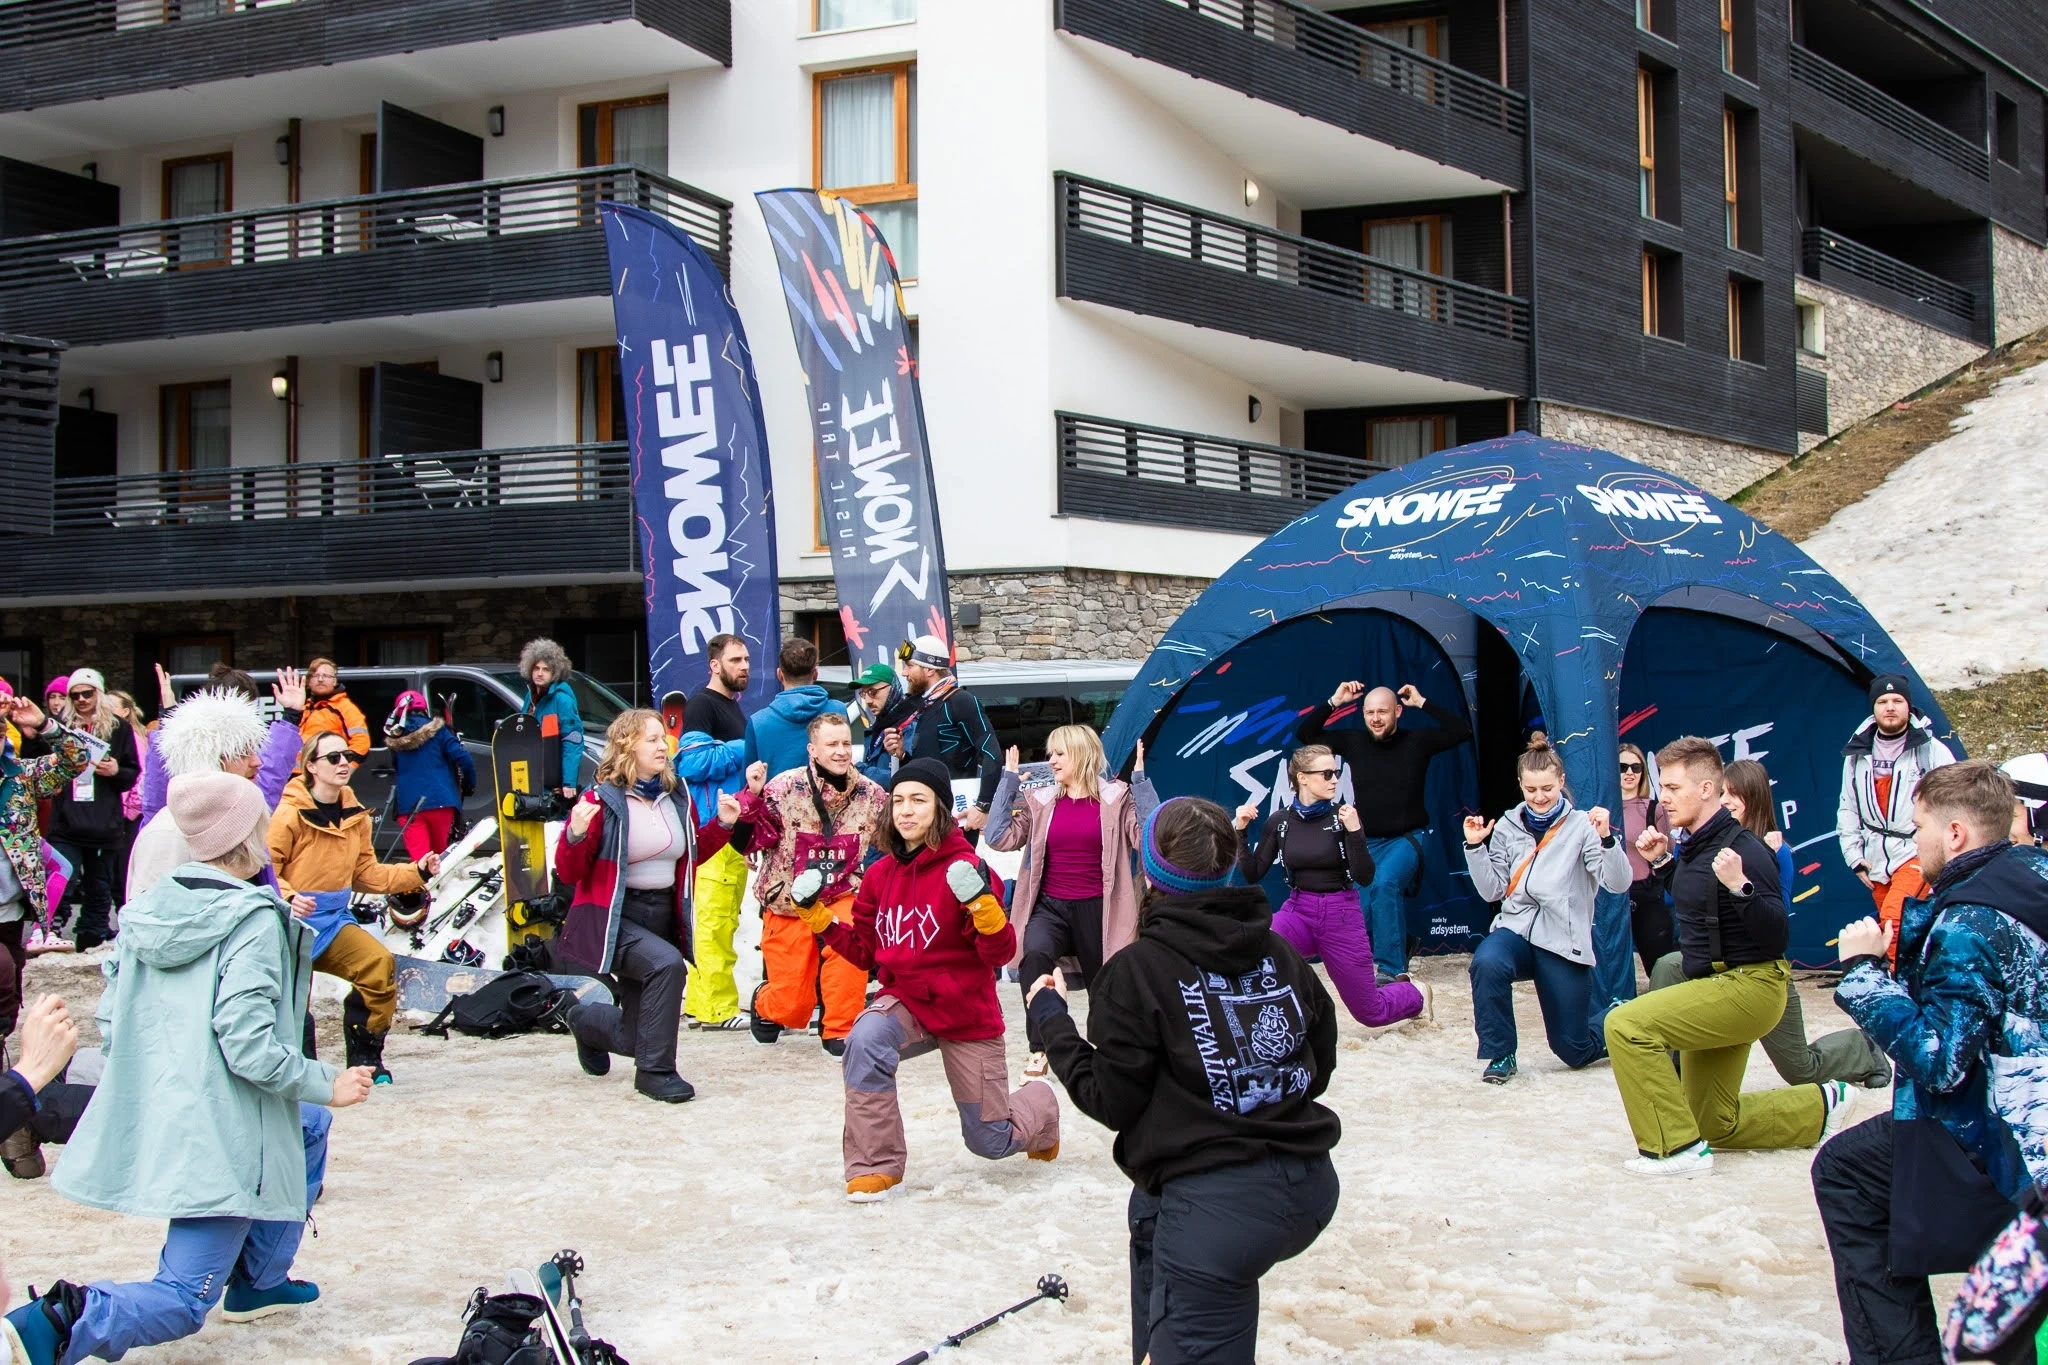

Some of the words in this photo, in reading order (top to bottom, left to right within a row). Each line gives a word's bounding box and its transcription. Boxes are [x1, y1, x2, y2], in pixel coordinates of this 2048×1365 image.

[1335, 483, 1516, 529] SNOWEE
[1575, 484, 1723, 525] SNOWEE
[78, 732, 106, 751] SNOWEE
[808, 849, 846, 860] BORN
[1430, 924, 1471, 937] adsystem.
